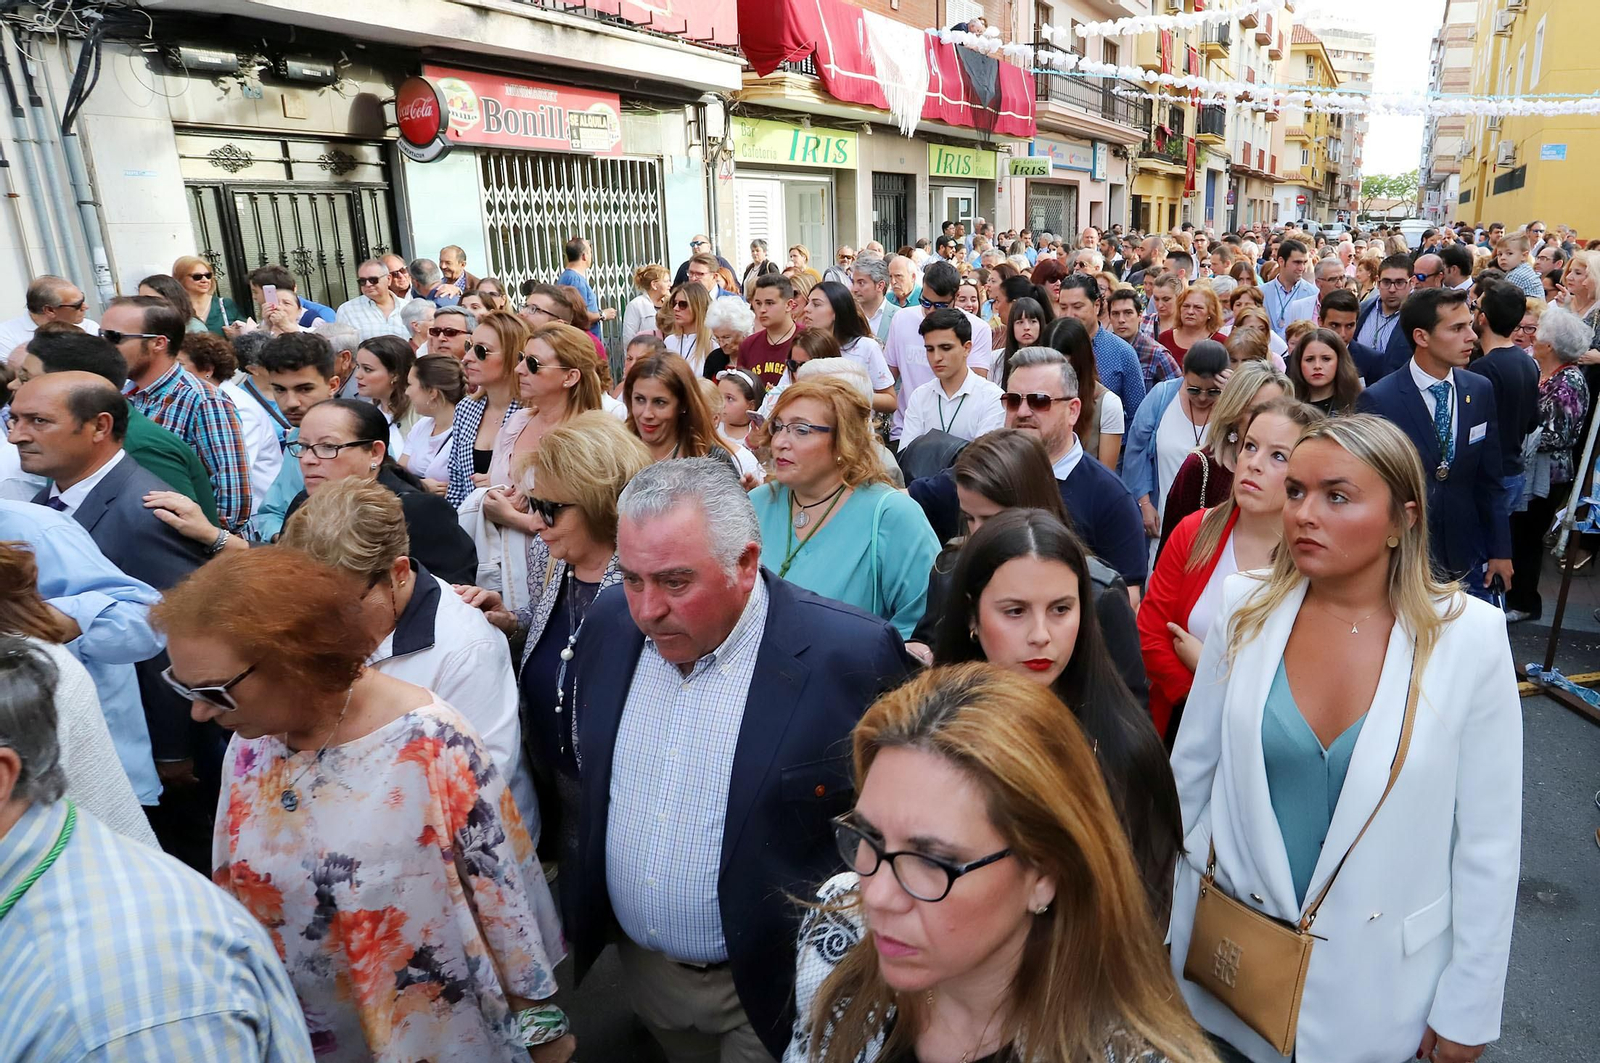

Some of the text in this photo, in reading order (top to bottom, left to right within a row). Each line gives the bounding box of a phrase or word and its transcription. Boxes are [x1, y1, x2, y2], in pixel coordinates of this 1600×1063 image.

[480, 97, 570, 141] Bonill
[569, 114, 607, 129] SE ALQUILA
[741, 121, 755, 137] Bar
[788, 129, 848, 164] IRIS
[936, 148, 971, 175] IRIS
[1013, 165, 1046, 175] IRIS
